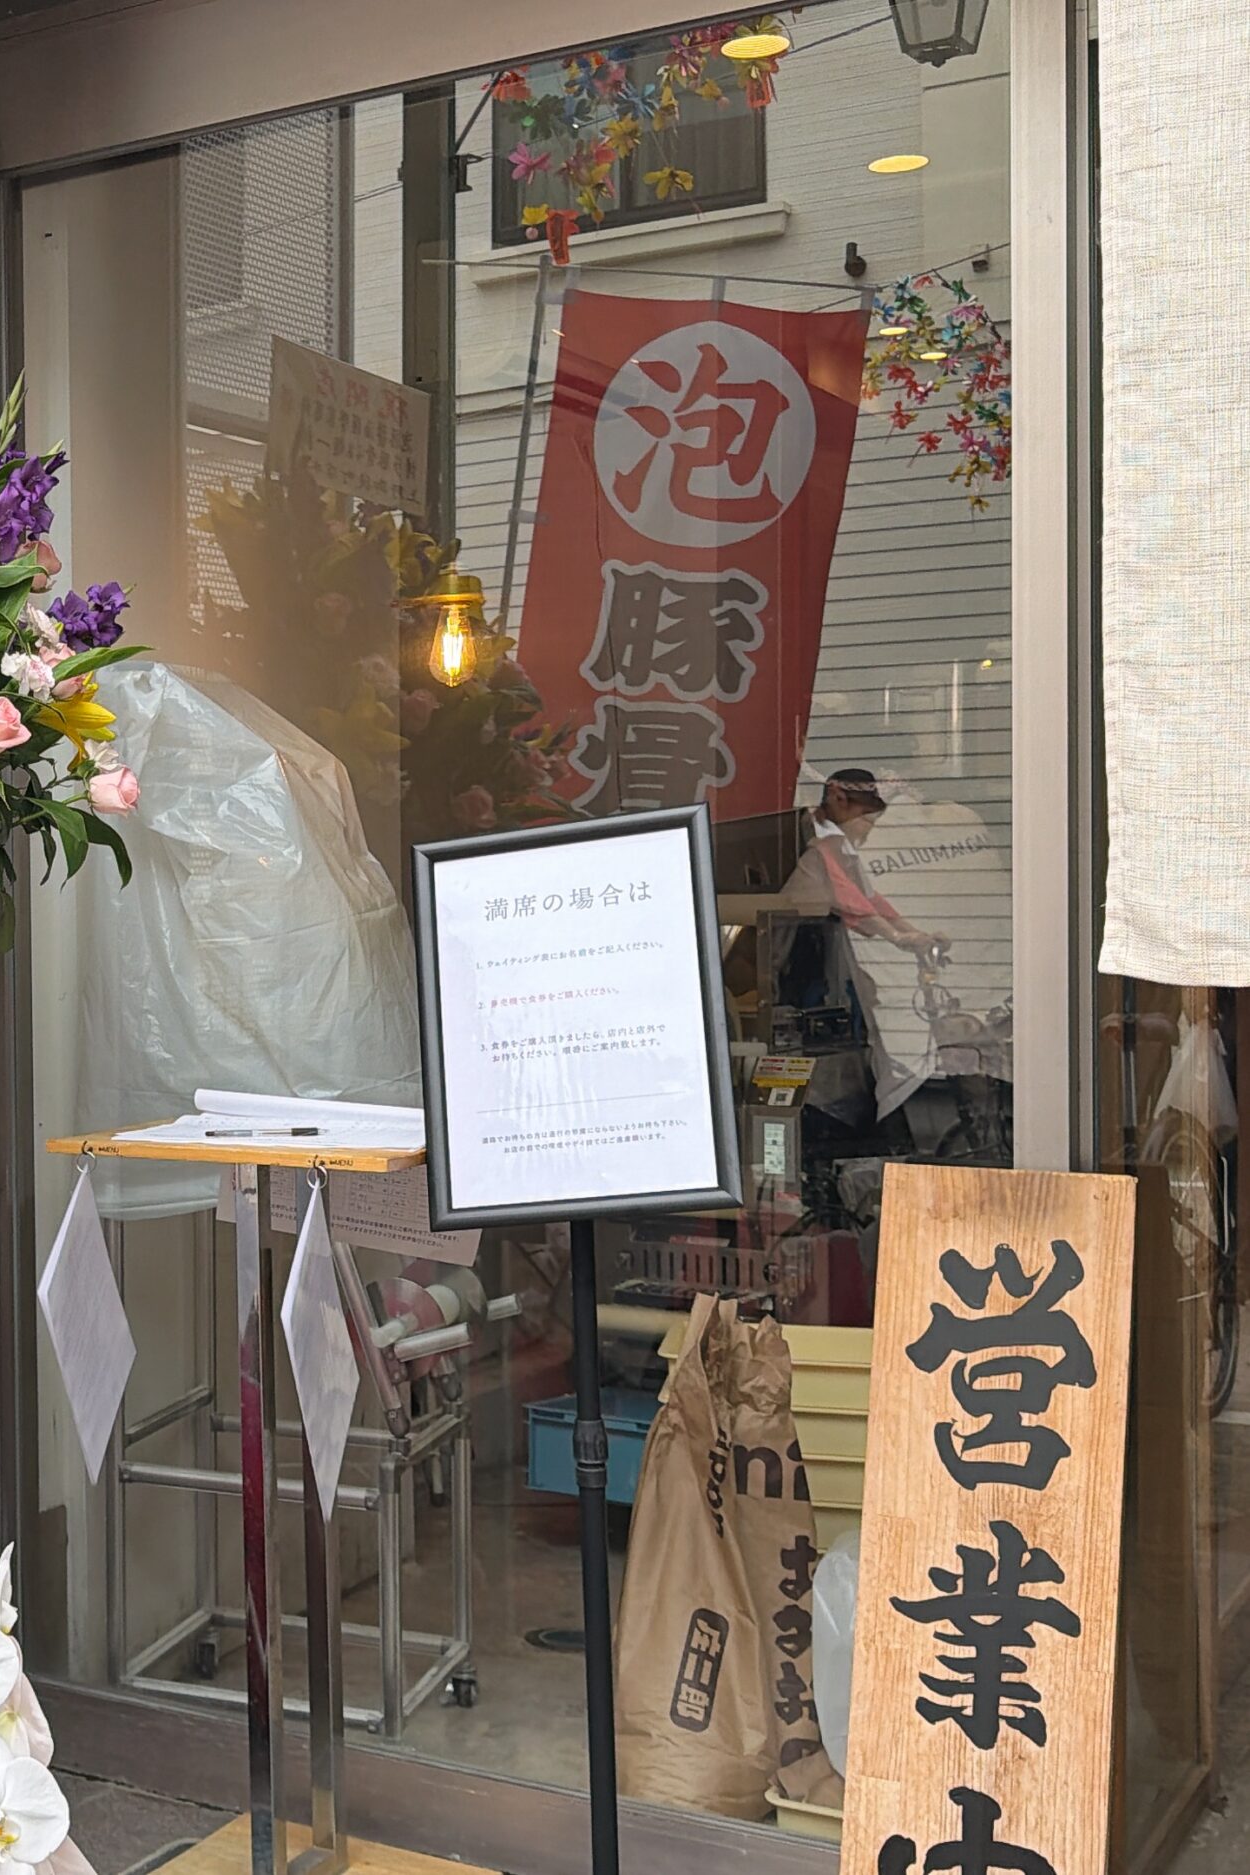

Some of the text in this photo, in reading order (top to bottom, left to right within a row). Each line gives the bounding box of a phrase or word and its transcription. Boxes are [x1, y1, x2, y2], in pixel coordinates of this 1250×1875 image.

[483, 880, 653, 922] 満席の場合は
